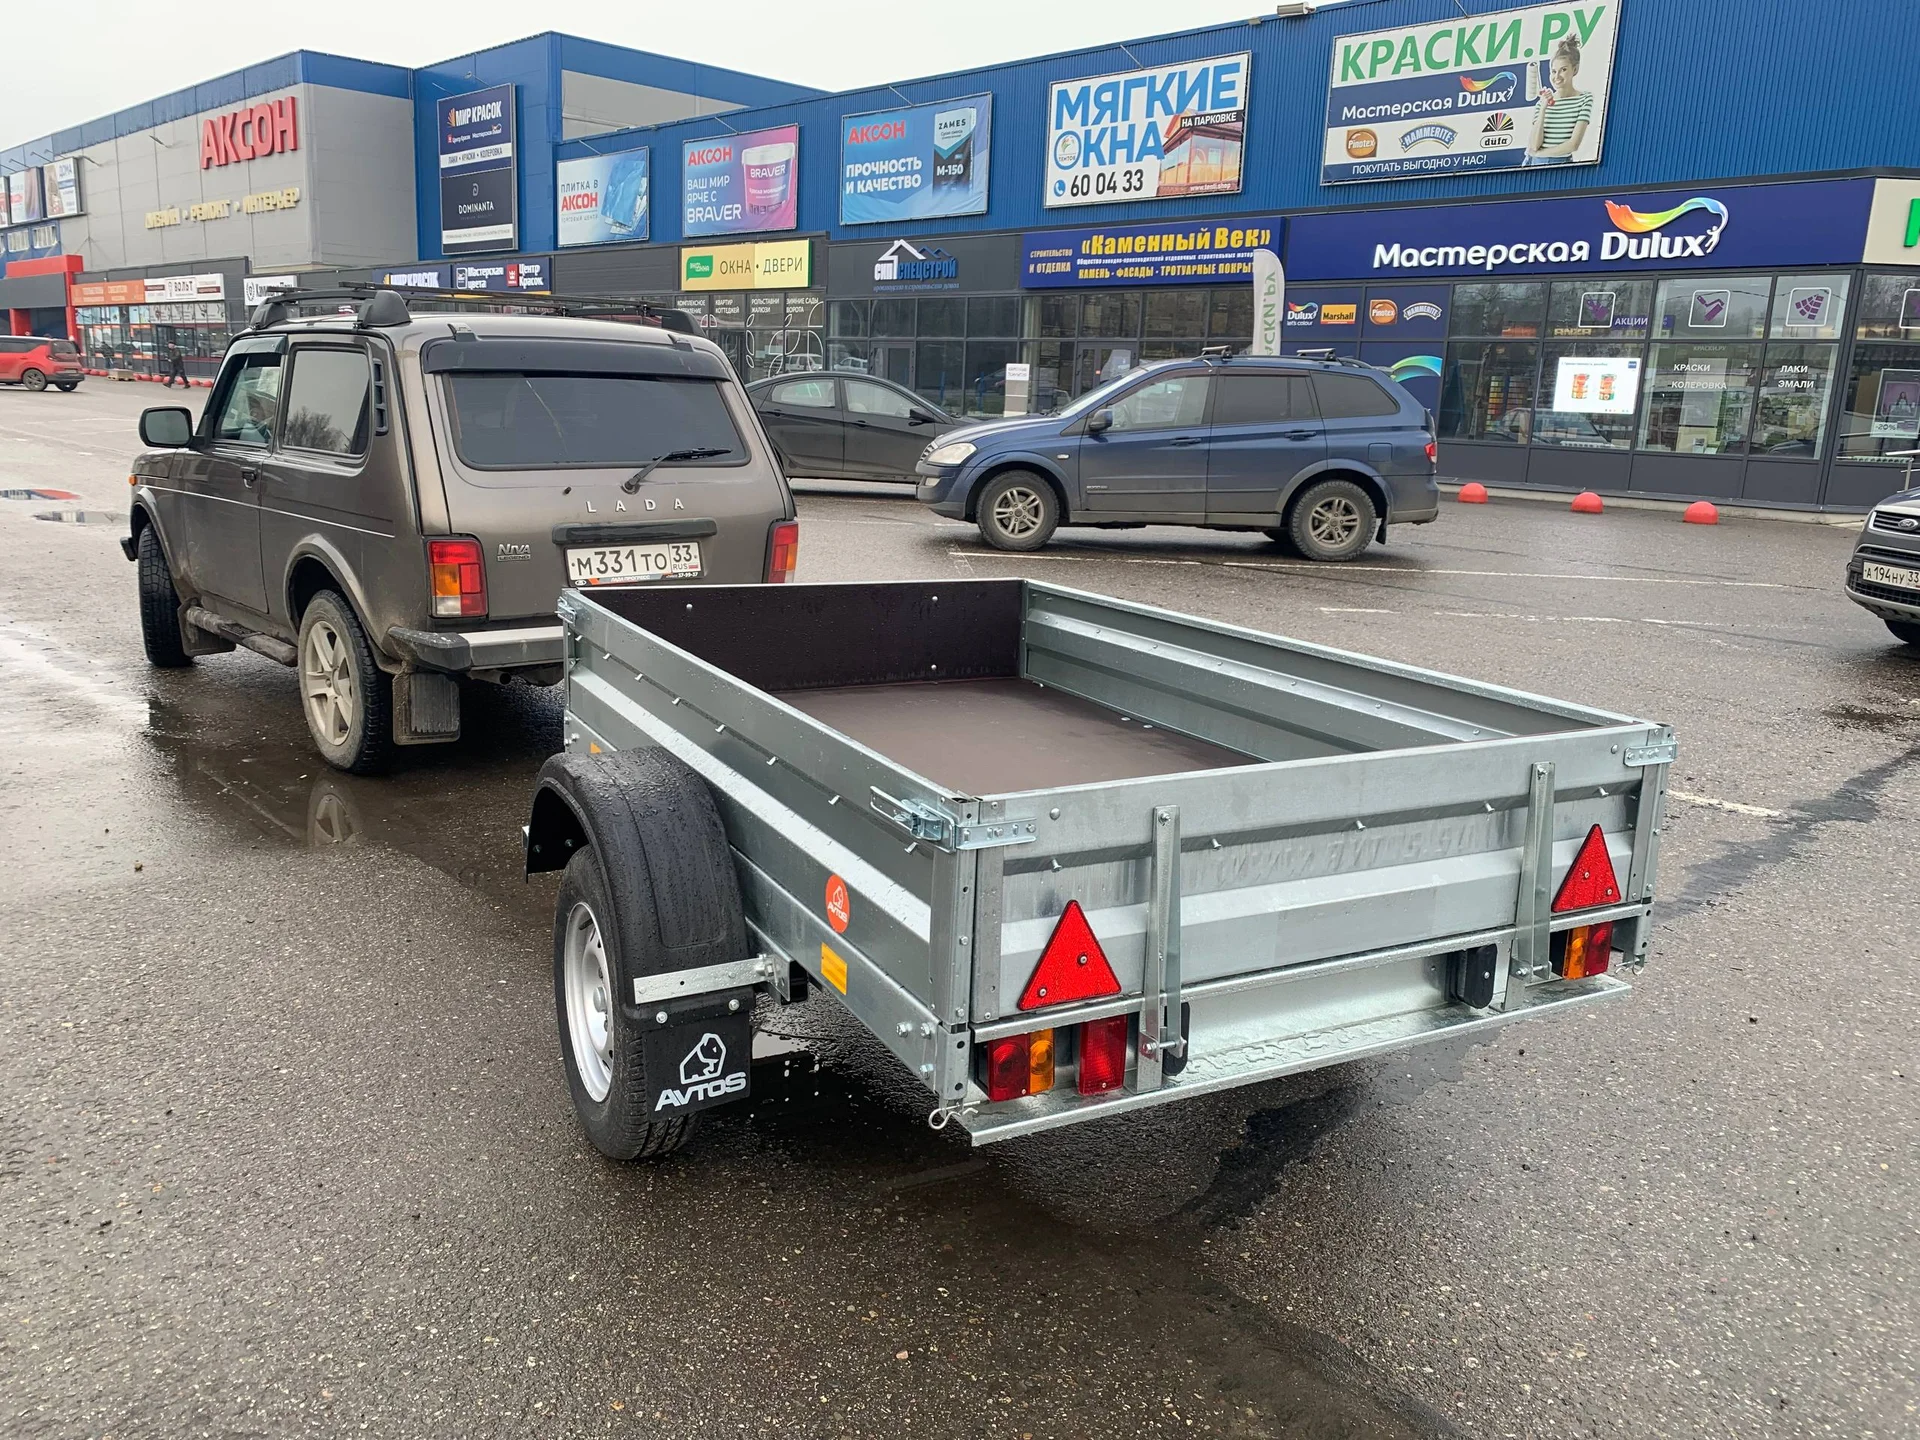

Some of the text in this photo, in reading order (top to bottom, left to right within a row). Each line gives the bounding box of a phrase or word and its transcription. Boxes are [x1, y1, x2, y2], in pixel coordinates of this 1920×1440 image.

[1340, 5, 1606, 82] КРАСКИ.РУ
[1055, 62, 1241, 130] МЯГКИЕ
[455, 100, 502, 127] МИР КРАСОК
[1342, 91, 1508, 121] Мастерская Dulux
[938, 119, 967, 130] ZAMES
[1181, 112, 1237, 128] НА ПАРКОВКЕ
[201, 96, 298, 169] АКСОН
[848, 120, 906, 144] АКСОН
[1404, 126, 1453, 146] HAMMERITE
[1053, 121, 1165, 170] ОКНА
[1348, 138, 1376, 150] Pinotex
[1484, 138, 1508, 147] düfa
[688, 145, 733, 166] АКСОН
[750, 164, 786, 178] BRAVER
[846, 156, 922, 178] ПРОЧНОСТЬ
[936, 164, 964, 176] М-150
[1352, 154, 1487, 175] ПОКУПАТЬ ВЫГОДНО У НАС!
[560, 179, 599, 193] ПЛИТКА В
[687, 175, 730, 191] ВАШ МИР
[846, 174, 922, 194] И КАЧЕСТВО
[1070, 169, 1144, 198] 60 04 33
[561, 192, 598, 211] АКСОН
[687, 191, 717, 204] ЯРЧЕ С
[458, 201, 494, 214] DOMINANTA
[687, 204, 742, 223] BRAVER
[1081, 227, 1271, 255] «Каменный Век»
[1030, 249, 1073, 258] СТРОИТЕЛЬСТВО
[1236, 250, 1254, 259] матер
[1372, 231, 1707, 271] Мастерская Dulux
[467, 266, 504, 279] Мастерская
[519, 264, 541, 276] Центр
[720, 256, 803, 276] ОКНА ДВЕРИ
[898, 257, 957, 281] СПЕЦСТРОЙ
[1029, 262, 1071, 274] И ОТДЕЛКА
[1078, 268, 1110, 279] КАМЕНЬ
[1116, 266, 1154, 278] ФАСАДЫ
[1160, 263, 1216, 276] ТРОТУАРНЫЕ
[174, 280, 193, 292] ВОЛЬТ
[408, 271, 439, 288] КРАСОК
[467, 278, 487, 290] цвета
[519, 276, 543, 289] Красок
[1287, 311, 1313, 320] Dulux
[1322, 312, 1354, 320] Marshall
[1372, 309, 1395, 317] Pinotex
[1614, 317, 1648, 327] АКЦИИ
[1674, 363, 1711, 372] КРАСКИ
[1780, 365, 1808, 373] ЛАКИ
[1671, 381, 1727, 390] КОЛЕРОВКА
[586, 498, 685, 513] LADA
[671, 545, 692, 562] 33
[1907, 571, 1920, 583] 33
[827, 901, 848, 923] AVTOS
[655, 1072, 747, 1112] AVTOS
